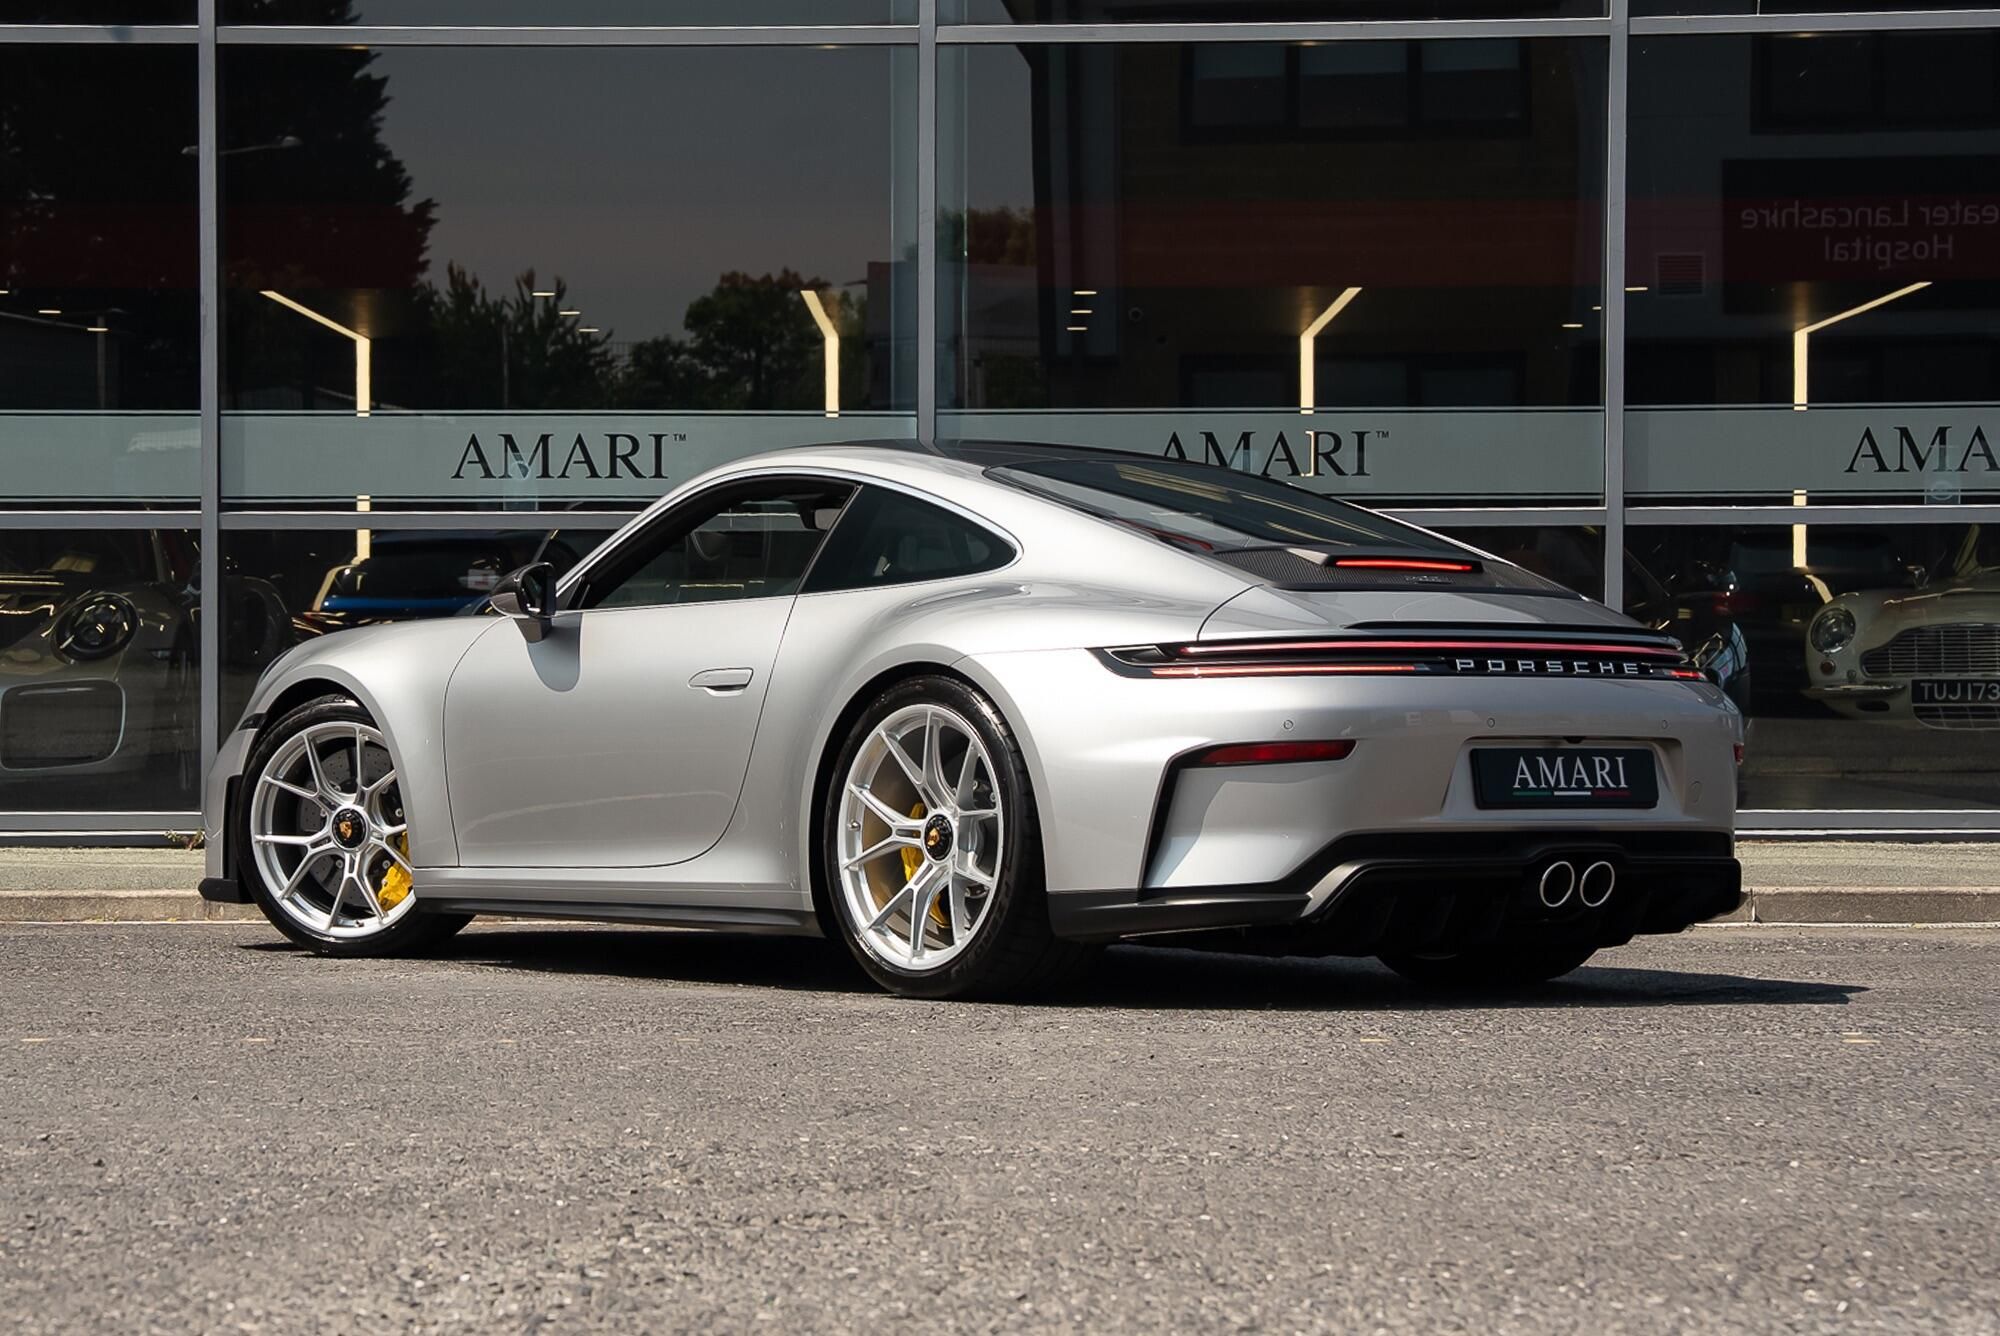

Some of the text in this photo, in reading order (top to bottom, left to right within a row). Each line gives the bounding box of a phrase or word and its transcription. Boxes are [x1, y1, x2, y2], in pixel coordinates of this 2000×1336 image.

[1455, 658, 1639, 675] PORSCHE
[1920, 682, 1962, 701] TUJ
[1512, 755, 1629, 789] AMARI
